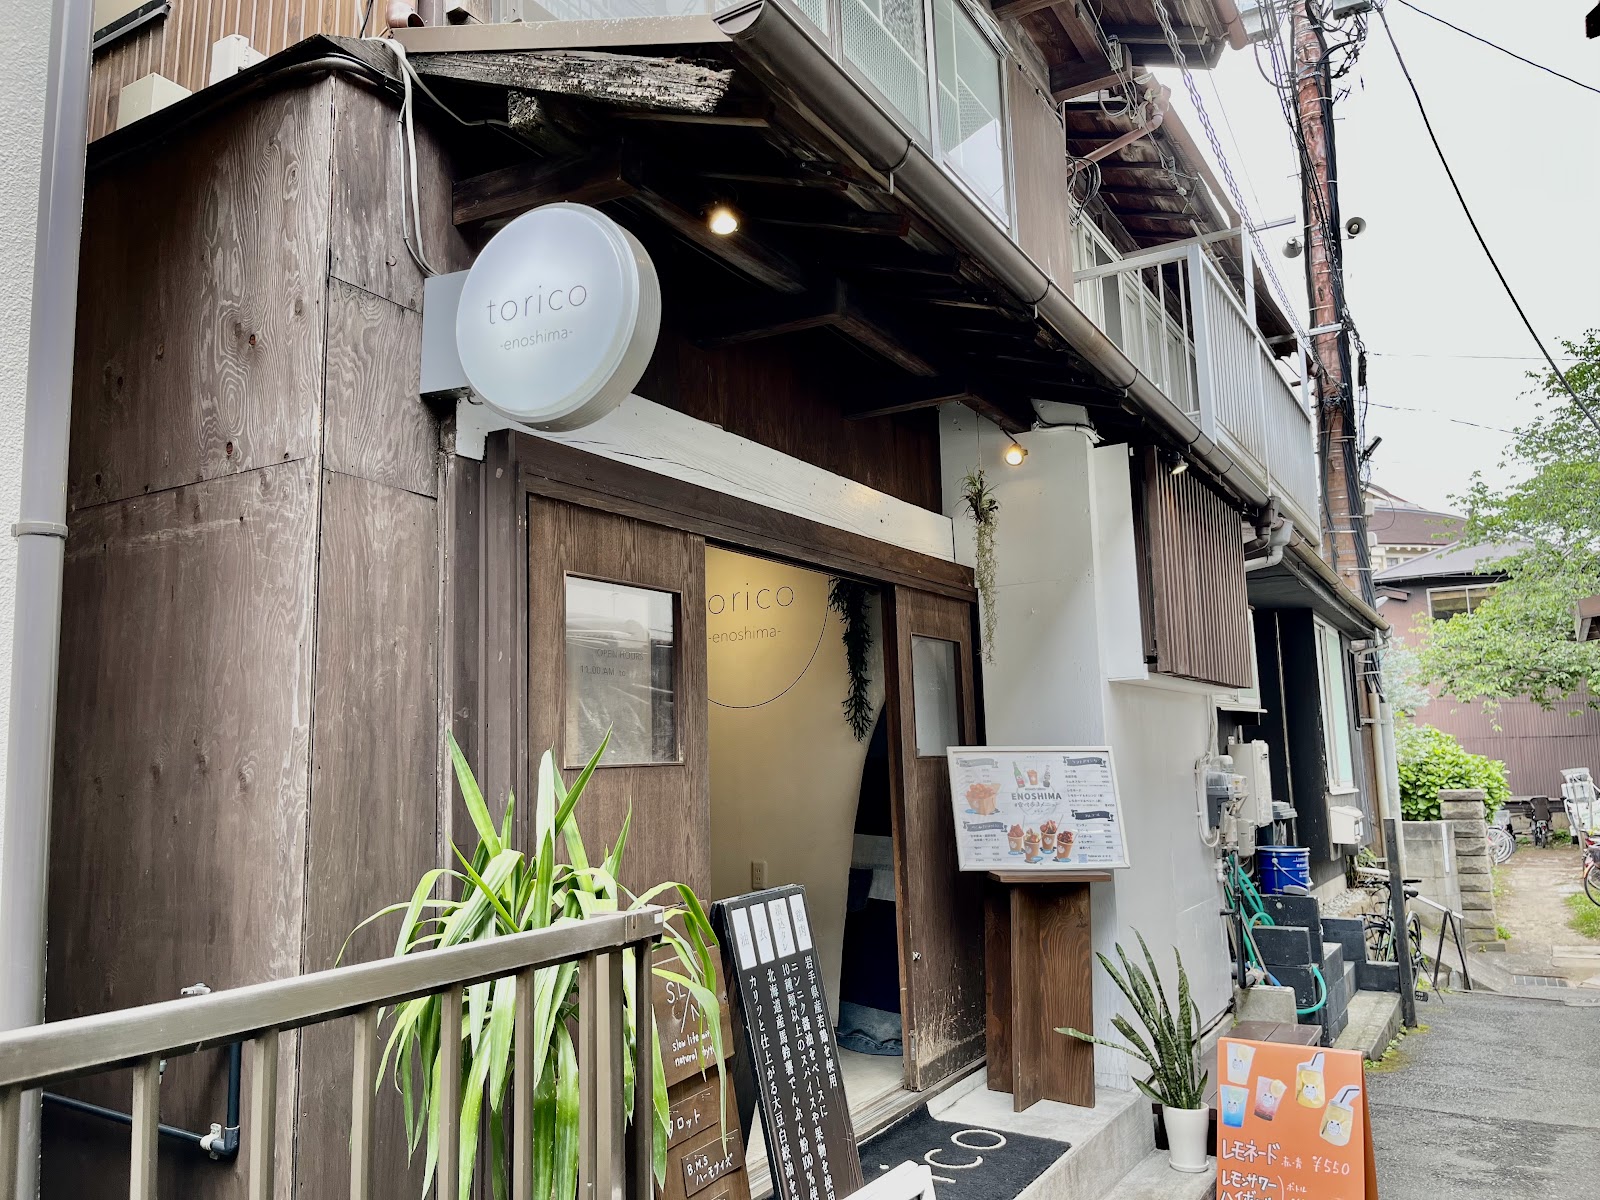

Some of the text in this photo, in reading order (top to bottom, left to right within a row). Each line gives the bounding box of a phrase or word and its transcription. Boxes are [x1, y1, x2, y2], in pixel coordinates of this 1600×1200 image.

[486, 284, 588, 325] torico
[707, 582, 795, 615] orico
[1011, 792, 1062, 801] ENOSHIMA
[804, 954, 838, 1089] 岩手県産若鶏を使用
[1221, 1138, 1281, 1166] レモネード
[1311, 1154, 1351, 1176] ¥550
[1220, 1169, 1278, 1191] レモンサワー
